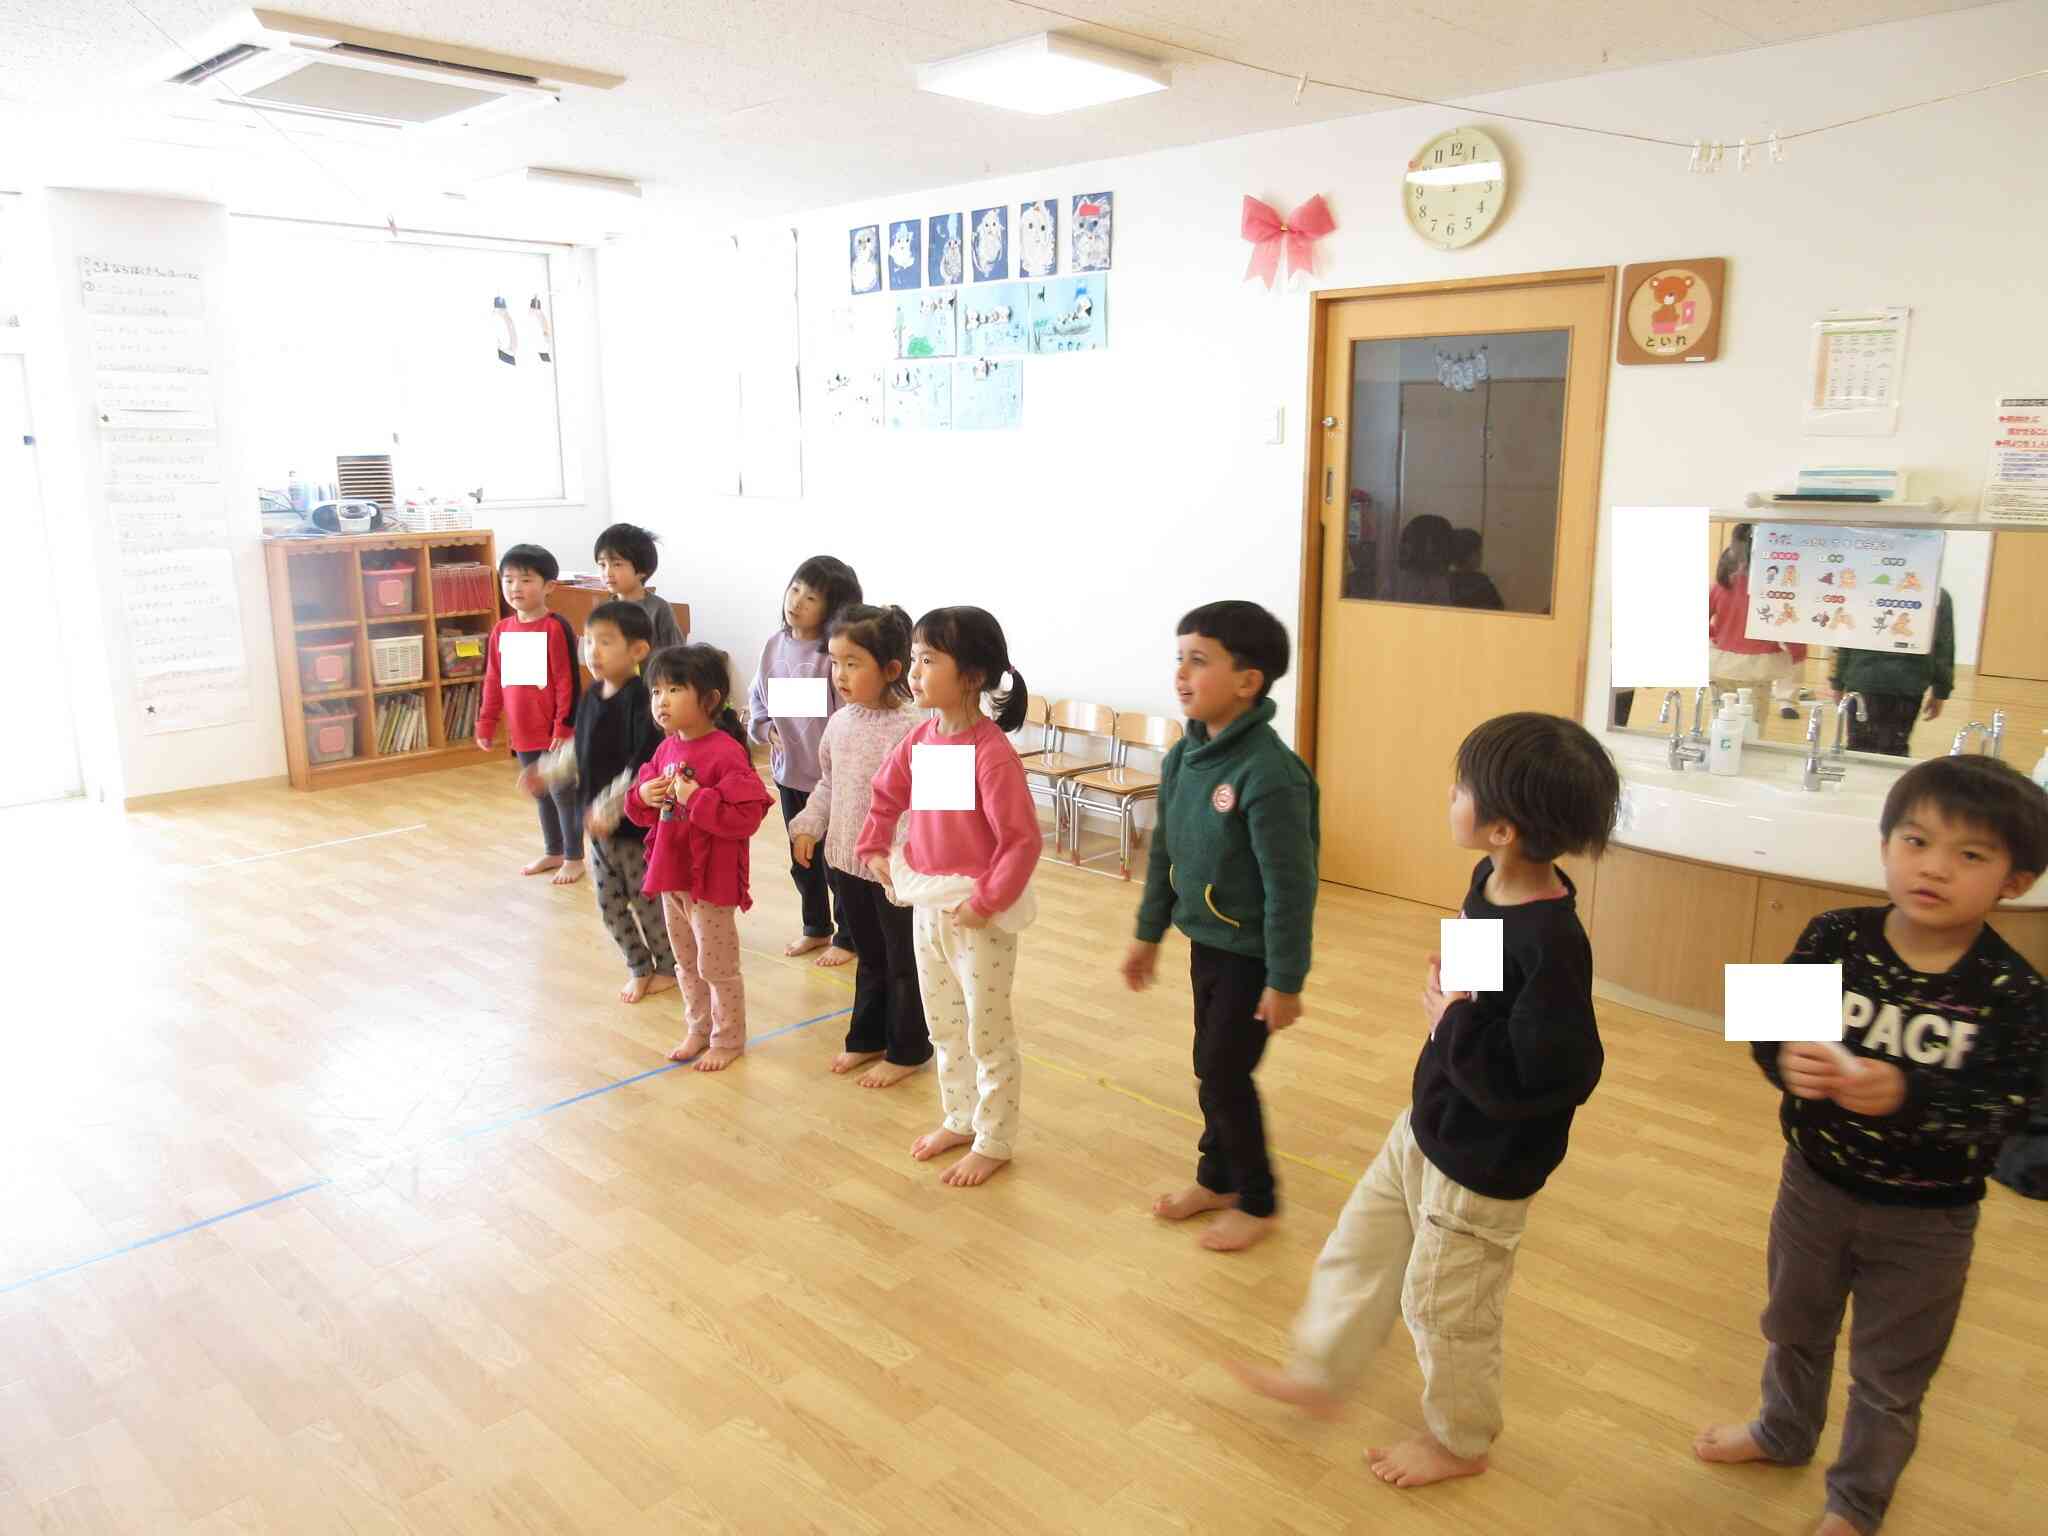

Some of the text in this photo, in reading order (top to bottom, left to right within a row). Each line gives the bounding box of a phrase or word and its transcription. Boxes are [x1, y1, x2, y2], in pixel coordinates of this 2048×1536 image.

[1434, 149, 1444, 164] 11
[1450, 142, 1463, 157] 12
[1415, 185, 1424, 199] 9
[1418, 205, 1426, 218] 8
[1475, 199, 1484, 213] 4
[1431, 218, 1438, 232] 7
[1446, 222, 1455, 236] 6
[1463, 216, 1472, 230] 5
[1646, 335, 1687, 347] といれ
